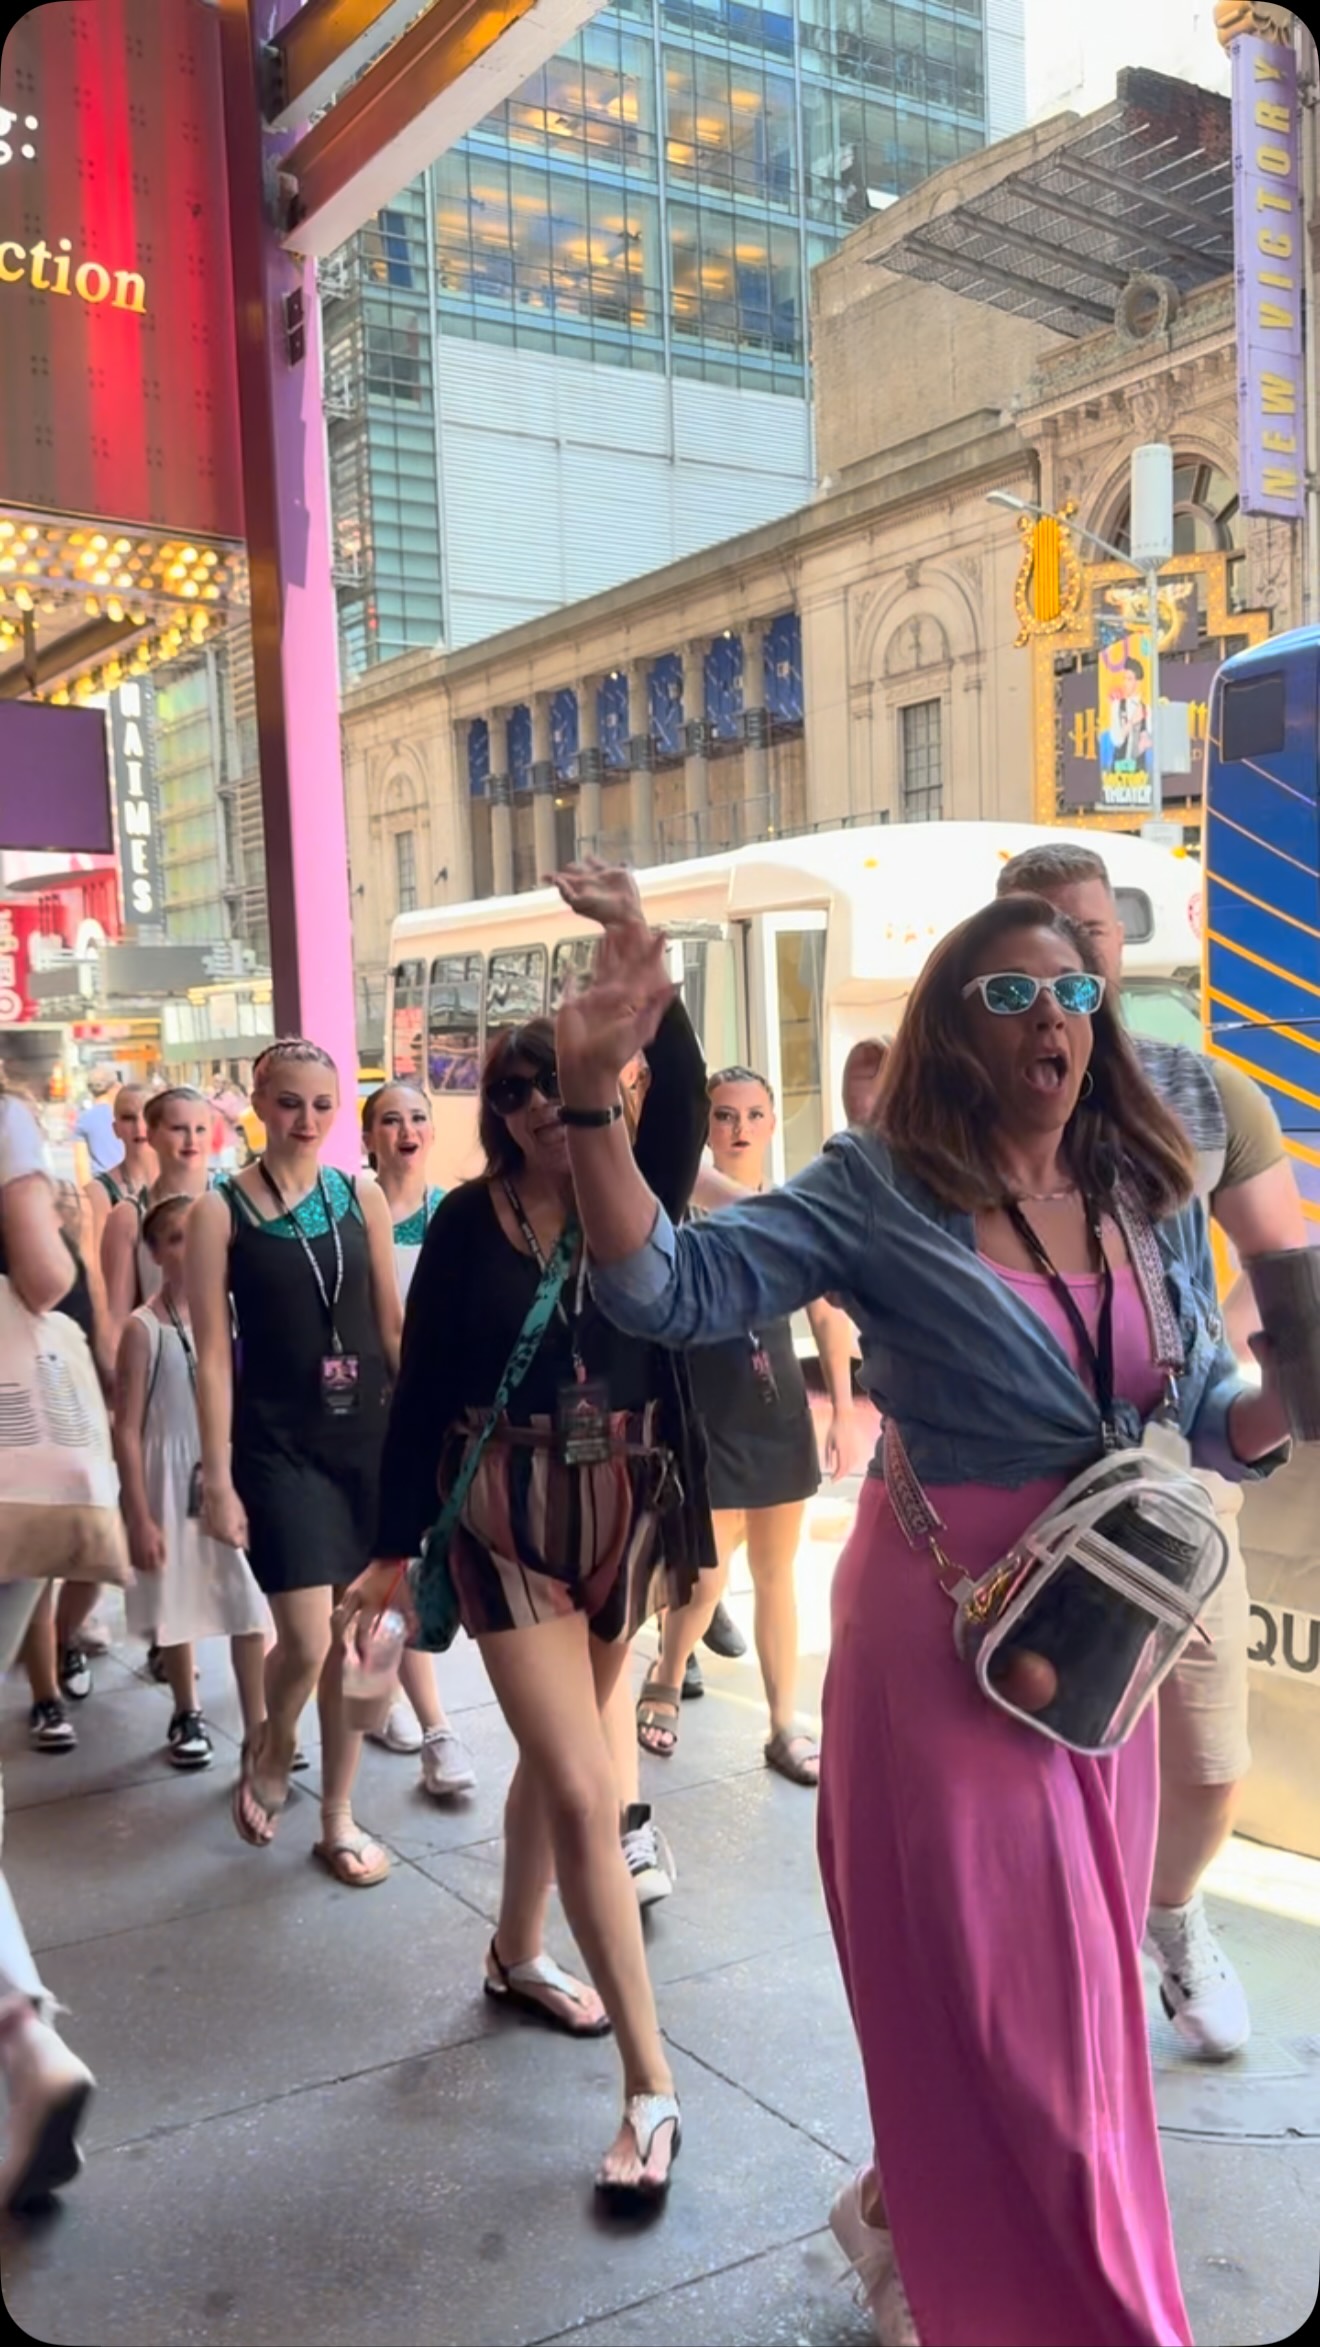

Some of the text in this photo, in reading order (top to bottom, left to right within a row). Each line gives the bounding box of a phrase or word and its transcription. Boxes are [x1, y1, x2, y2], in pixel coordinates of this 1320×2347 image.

[0, 238, 147, 314] ction
[1254, 56, 1298, 501] NEW VICTORY
[119, 682, 153, 914] HAIMES
